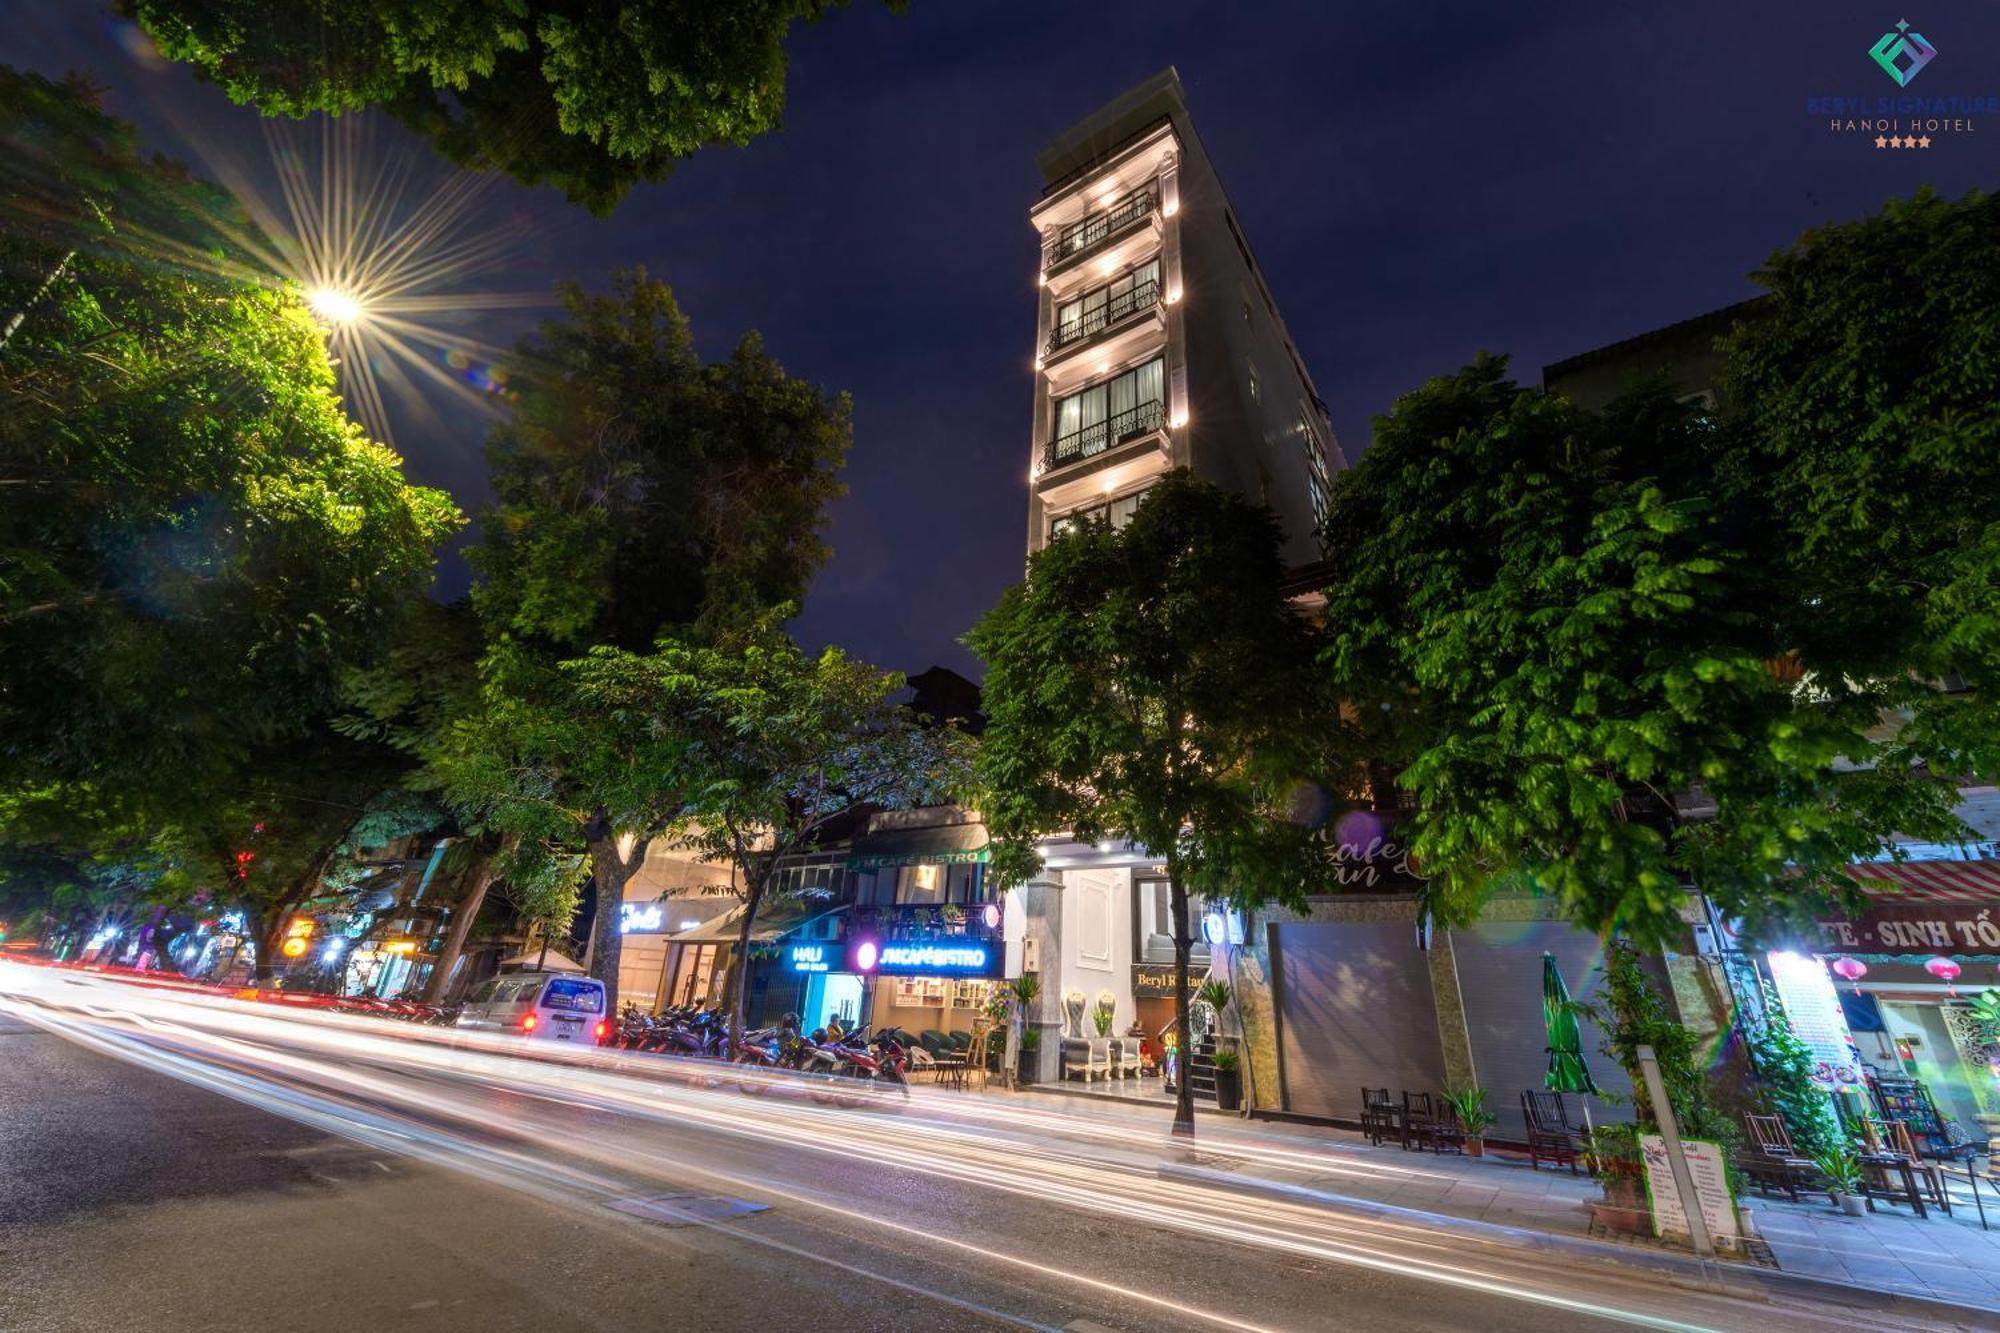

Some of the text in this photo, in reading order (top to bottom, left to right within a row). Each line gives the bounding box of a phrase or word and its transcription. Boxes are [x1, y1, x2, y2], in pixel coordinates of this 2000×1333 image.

[1877, 921, 1954, 947] SINH
[1955, 909, 2000, 947] TỐ
[1138, 973, 1166, 989] Beryl
